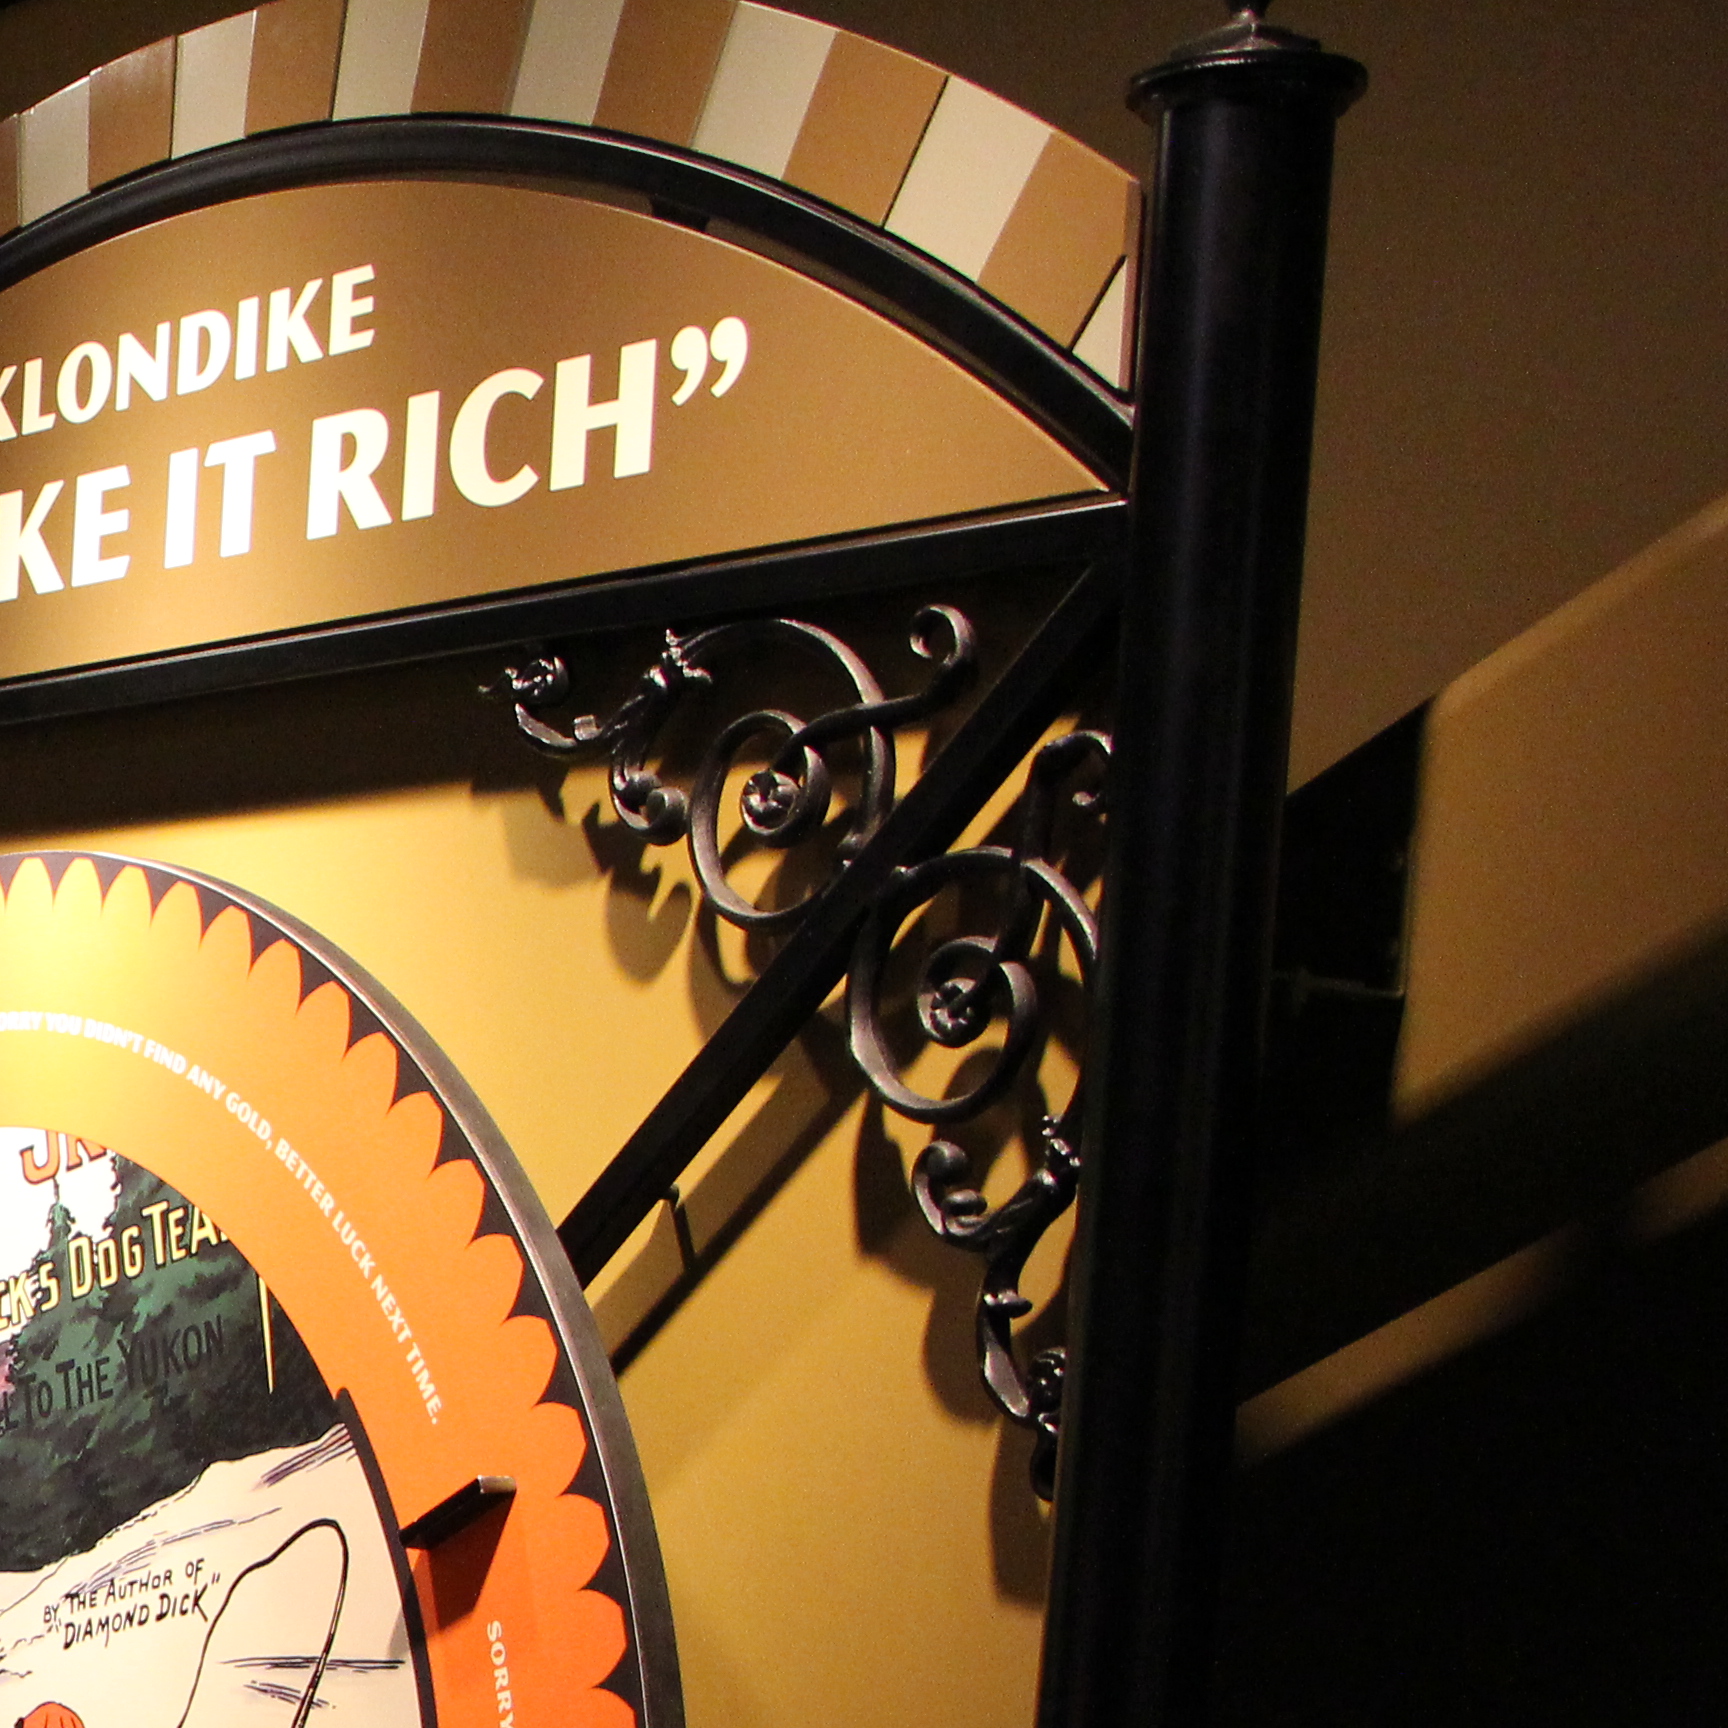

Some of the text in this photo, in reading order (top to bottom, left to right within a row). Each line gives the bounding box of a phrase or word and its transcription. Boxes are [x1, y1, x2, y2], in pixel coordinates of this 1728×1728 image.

[163, 429, 277, 569] IT
[306, 316, 748, 541] RICH"
[44, 1012, 82, 1036] YOU
[84, 1018, 144, 1053] DIDN'T
[144, 1039, 187, 1075] FIND
[186, 1064, 226, 1100] ANY
[225, 1092, 273, 1150] GOLD,
[274, 1138, 335, 1217] BETTER
[332, 1210, 376, 1279] LUCK
[371, 1275, 413, 1343] NEXT
[406, 1343, 442, 1425] TIME.
[68, 1225, 144, 1301] DOG
[141, 1200, 230, 1270] TEA
[16, 1372, 53, 1425] TO
[55, 1357, 113, 1411] THE
[117, 1314, 224, 1390] YUKON
[44, 1558, 204, 1623] BY THE AUTHOR OF
